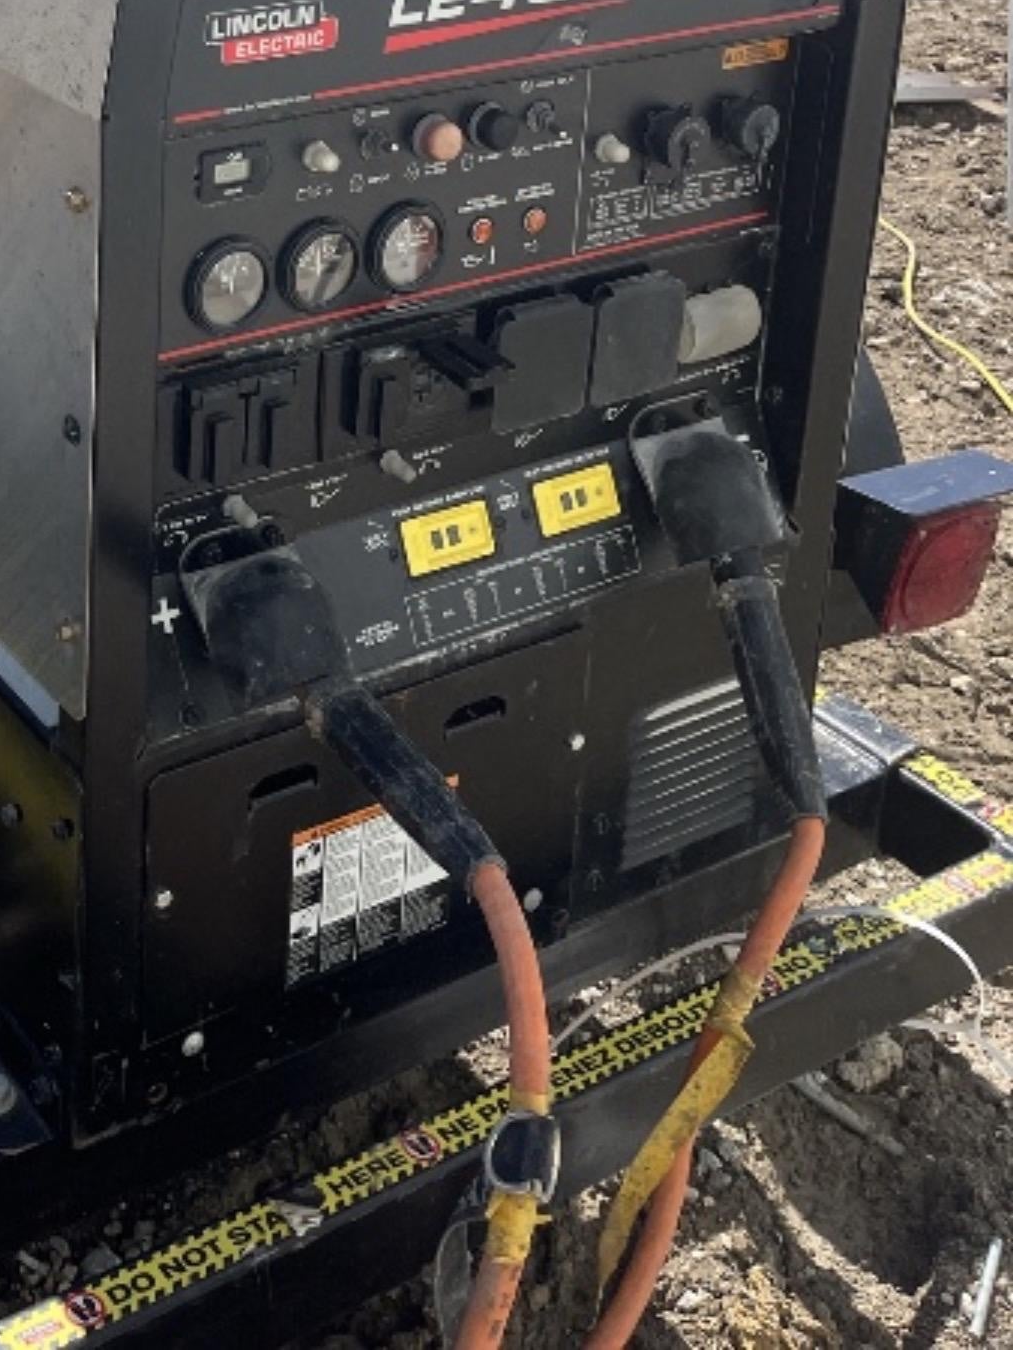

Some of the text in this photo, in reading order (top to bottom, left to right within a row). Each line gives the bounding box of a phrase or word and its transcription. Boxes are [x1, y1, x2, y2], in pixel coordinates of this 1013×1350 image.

[210, 4, 316, 40] LINCOLN
[235, 29, 324, 59] ELECTRIC
[438, 1002, 710, 1141] NE PA ENEZ DEBOUT
[106, 1148, 408, 1307] DO NOT STA HERE
